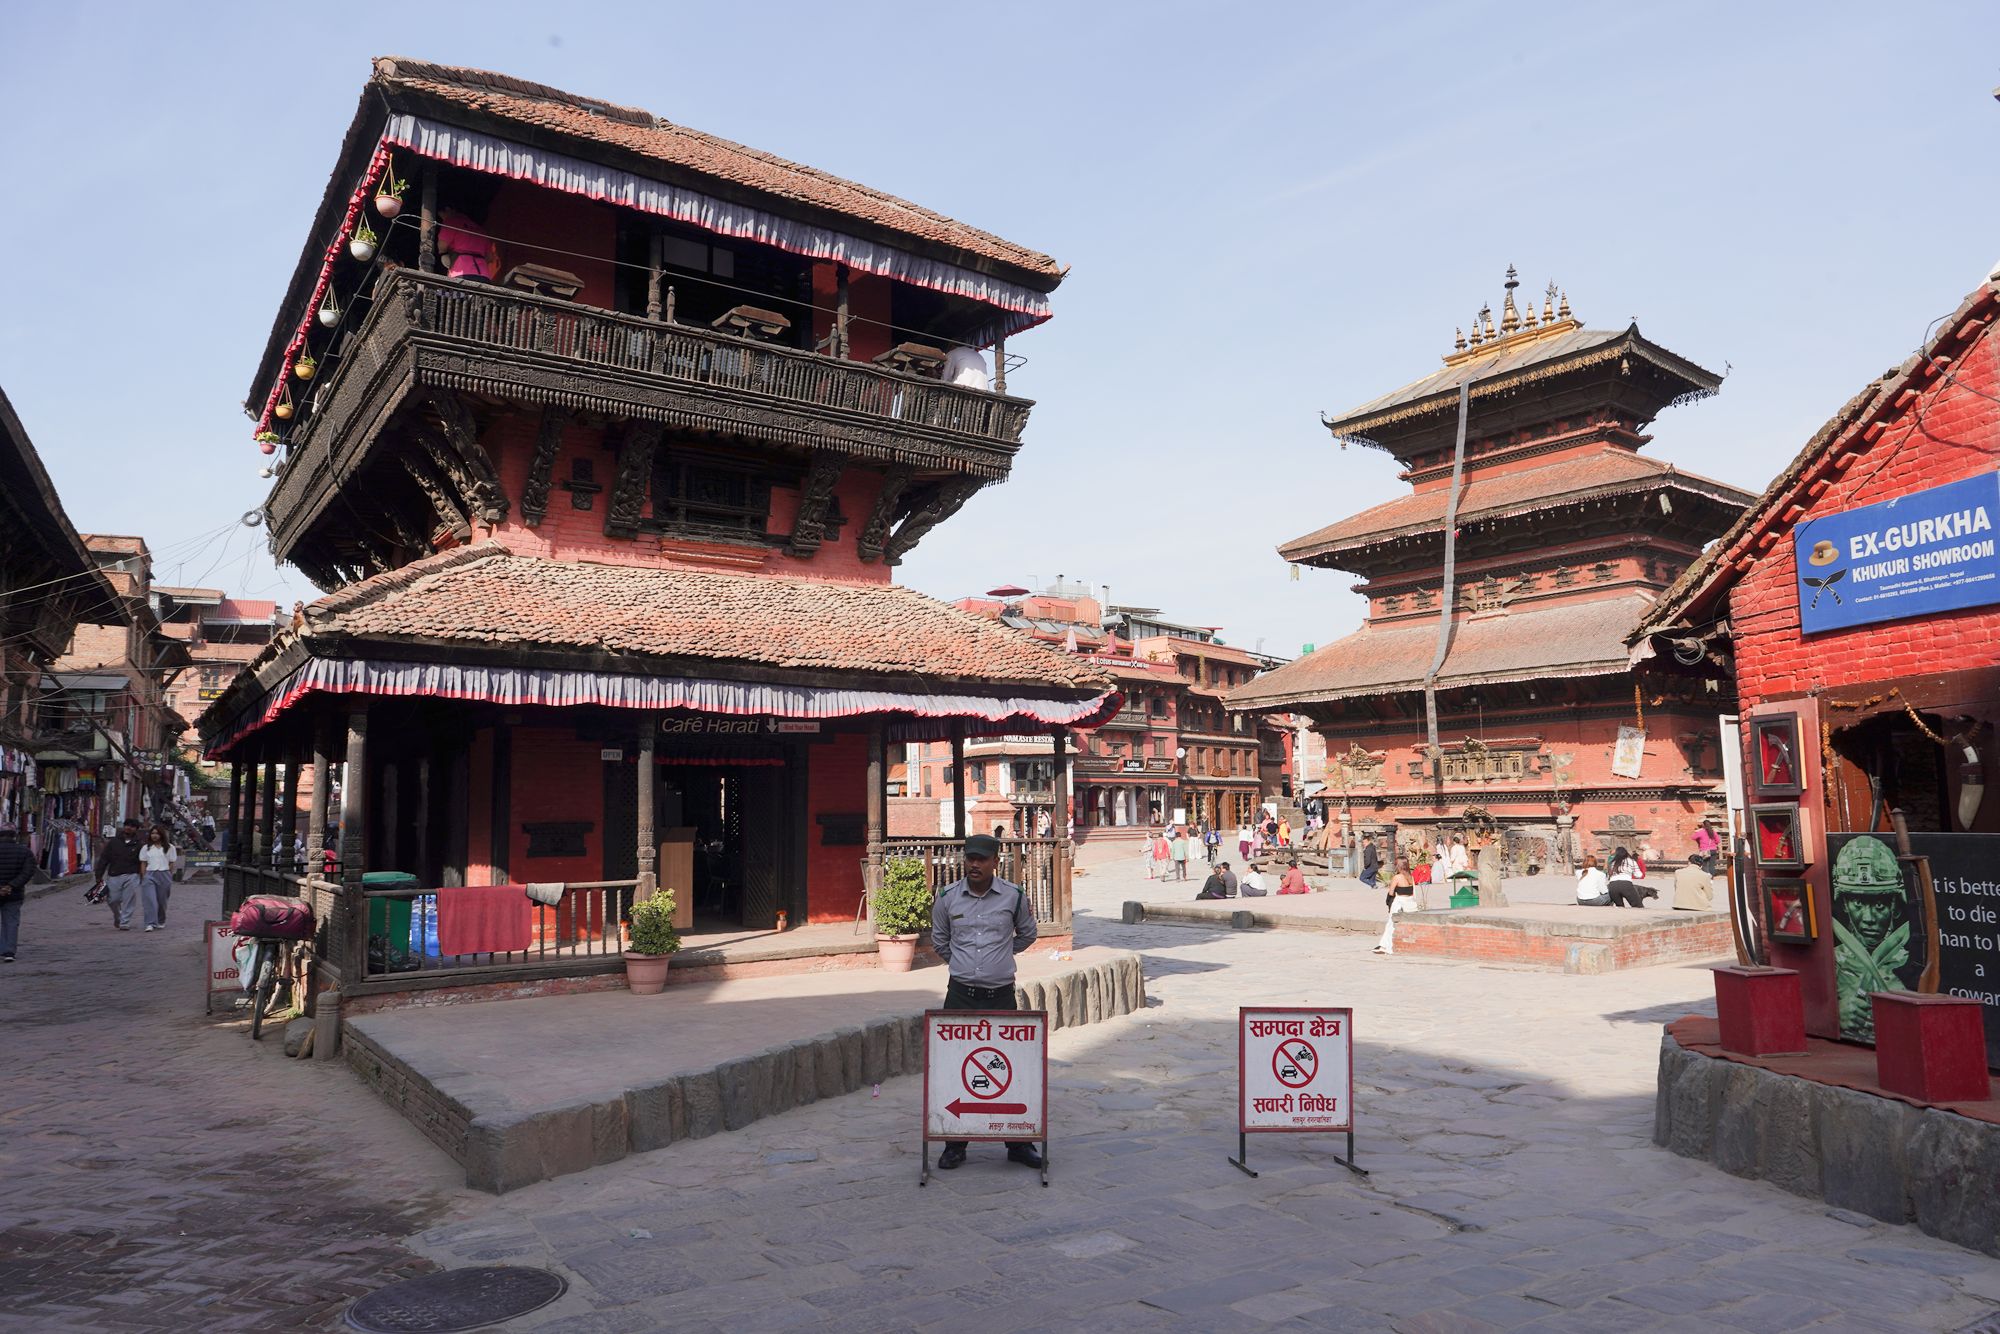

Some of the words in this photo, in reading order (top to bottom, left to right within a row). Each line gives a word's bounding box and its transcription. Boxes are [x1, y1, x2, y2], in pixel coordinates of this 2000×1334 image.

[1850, 506, 1991, 560] EX-GURKHA
[1852, 558, 1909, 583] KHUKURI
[1913, 539, 1994, 571] SHOWROOM
[1096, 656, 1112, 665] Lotus
[707, 718, 760, 733] Harati
[1003, 735, 1033, 743] NAMASTE
[602, 751, 621, 759] OPEN
[1933, 878, 1941, 893] t
[1944, 877, 1956, 894] is
[1960, 877, 2000, 896] bette
[1948, 905, 1966, 921] to
[1970, 905, 1996, 924] die
[1938, 928, 1970, 948] han
[1974, 934, 1992, 950] to
[1975, 964, 1985, 977] a
[937, 1019, 992, 1041] सवारी
[998, 1024, 1036, 1041] यता
[1249, 1020, 1305, 1037] सम्पदा
[1309, 1016, 1341, 1037] क्षेत्र
[1253, 1093, 1294, 1113] सवारी
[1298, 1093, 1337, 1112] निषेध
